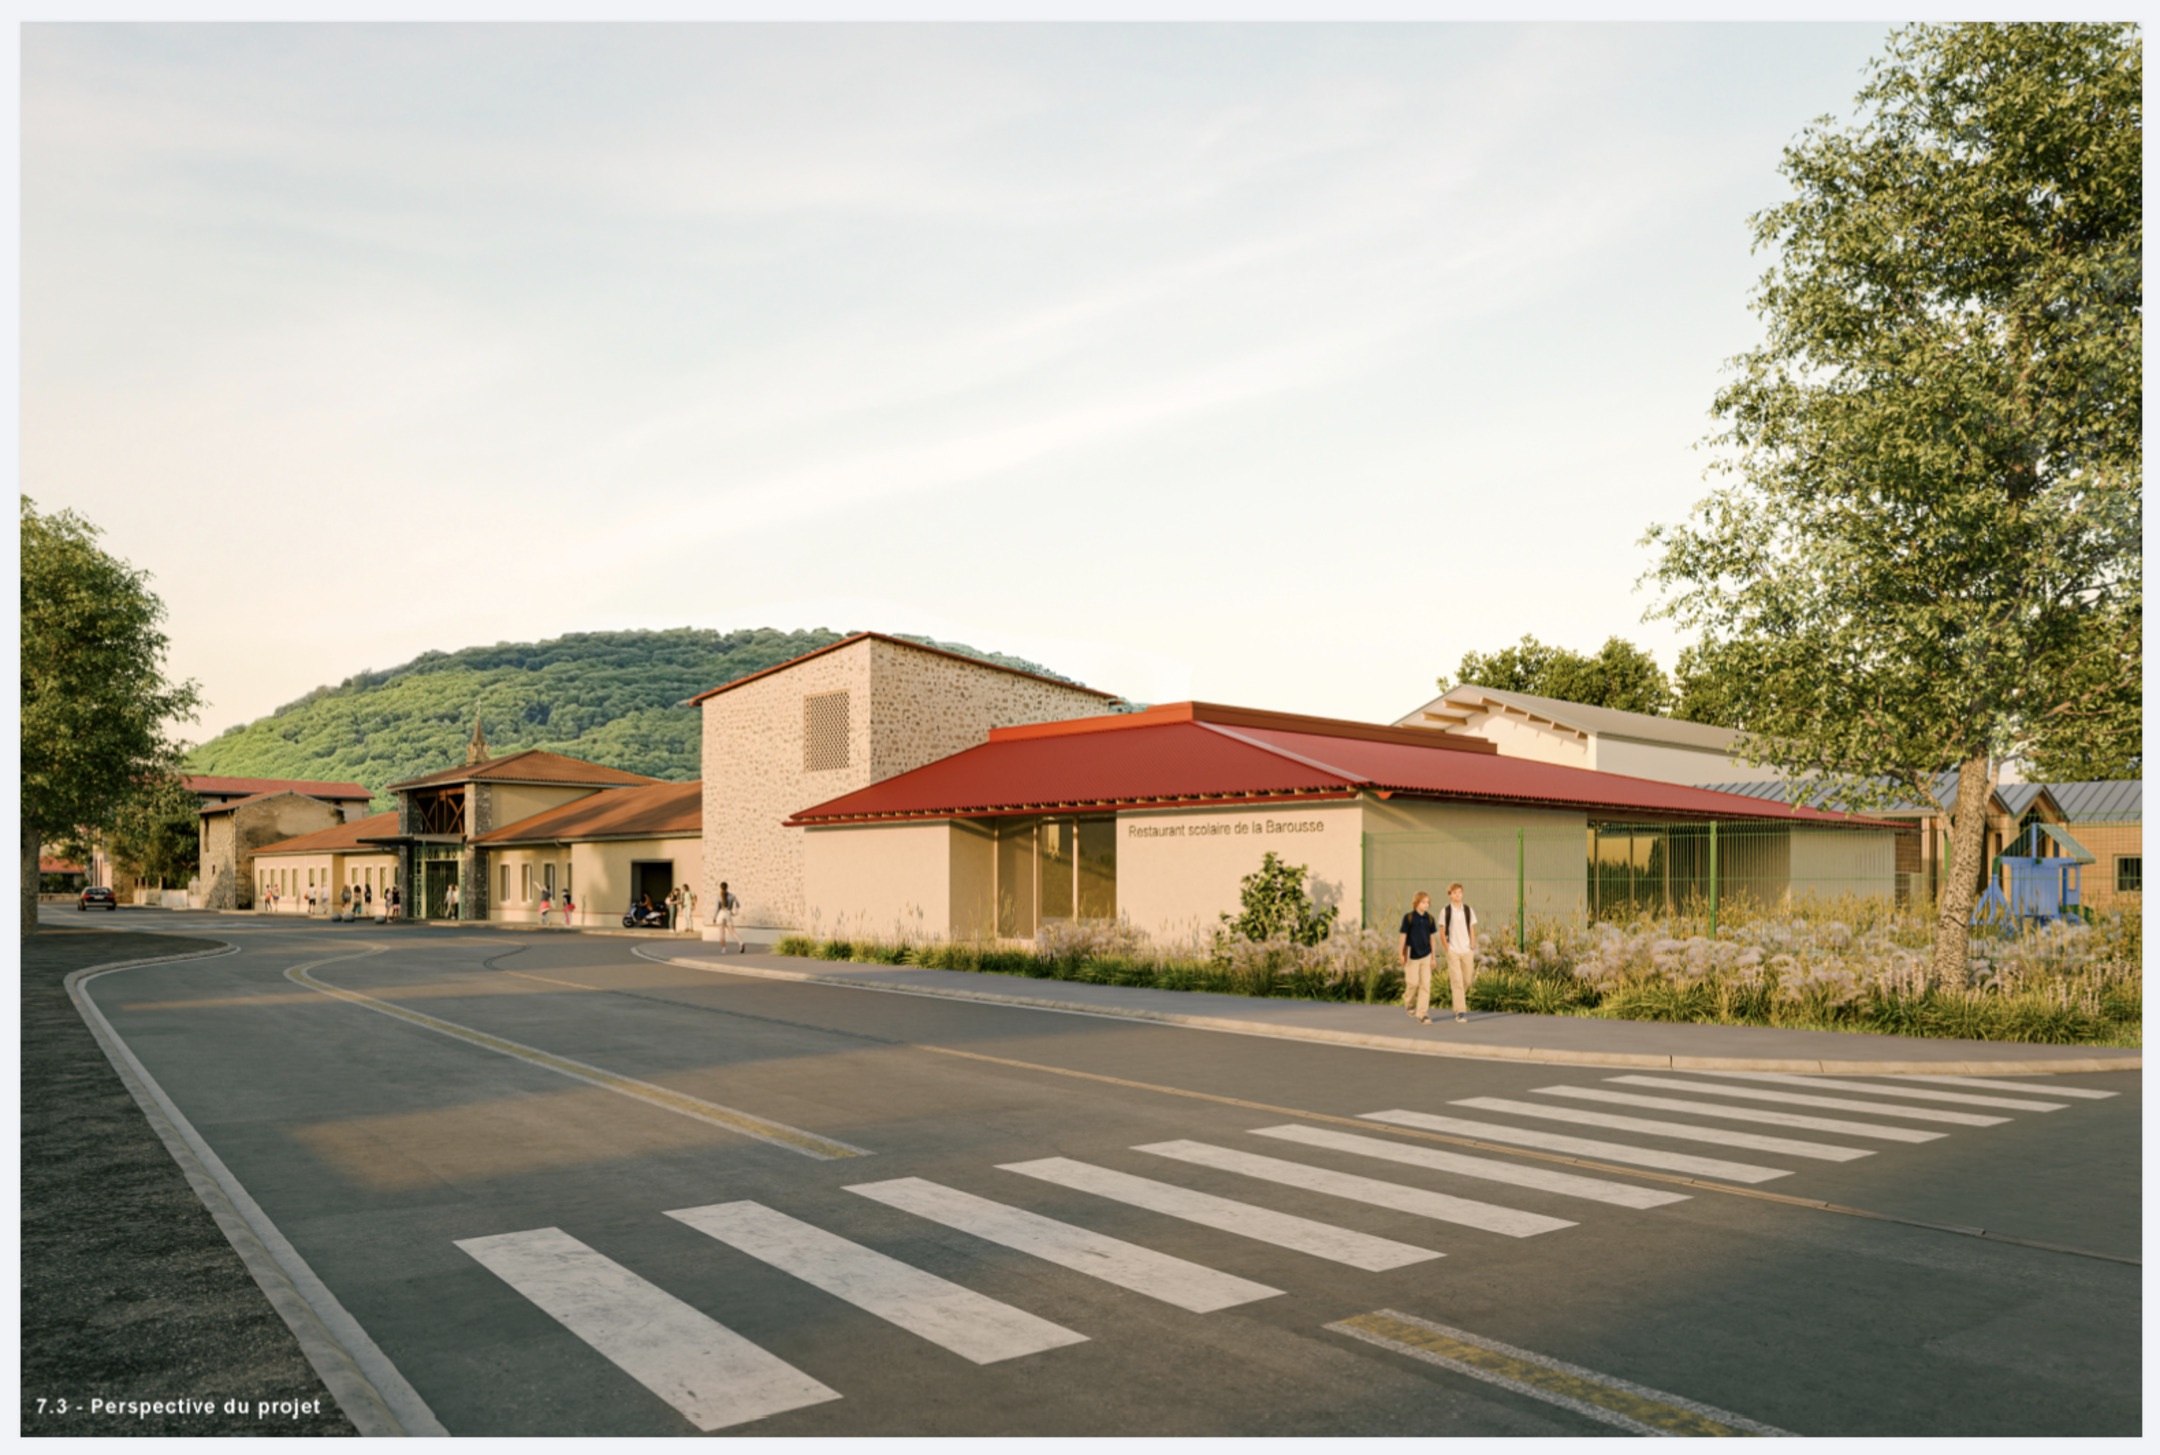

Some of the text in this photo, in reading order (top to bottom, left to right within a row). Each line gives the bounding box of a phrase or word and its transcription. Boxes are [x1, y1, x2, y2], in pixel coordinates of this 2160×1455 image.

[1128, 819, 1324, 838] Restaurant scolaire de la Barousse
